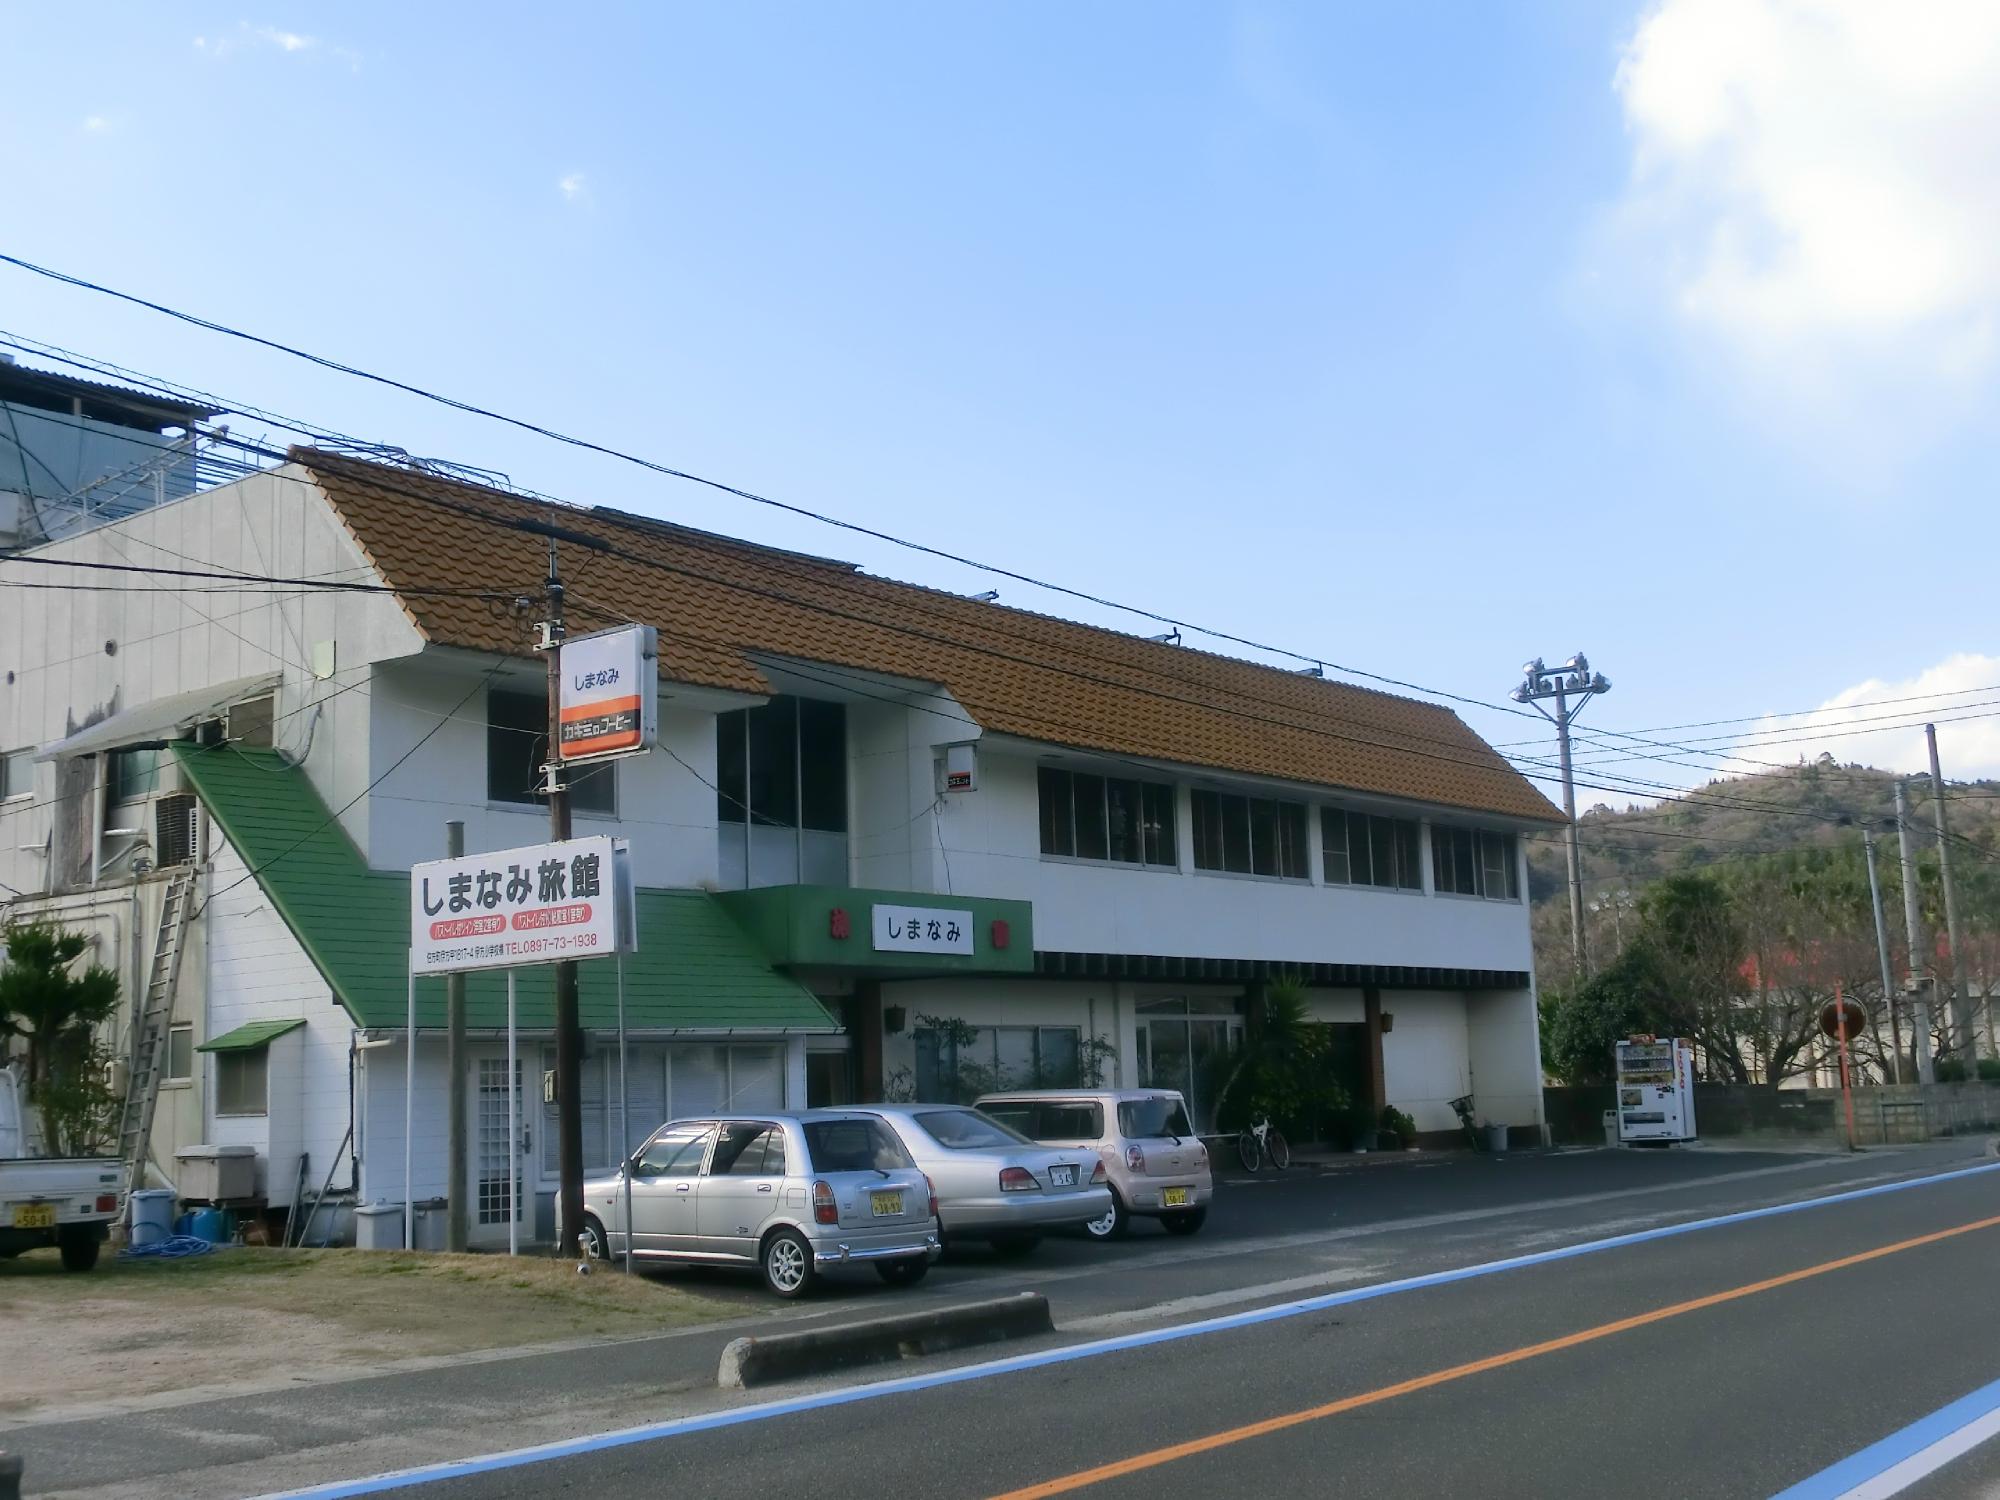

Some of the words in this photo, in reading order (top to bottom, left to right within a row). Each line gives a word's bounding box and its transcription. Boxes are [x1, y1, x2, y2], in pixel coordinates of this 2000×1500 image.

[575, 668, 620, 691] しまなみ
[423, 853, 600, 916] しまなみ旅館
[888, 917, 961, 942] しまなみ
[505, 933, 597, 955] TEL0897-73-1938
